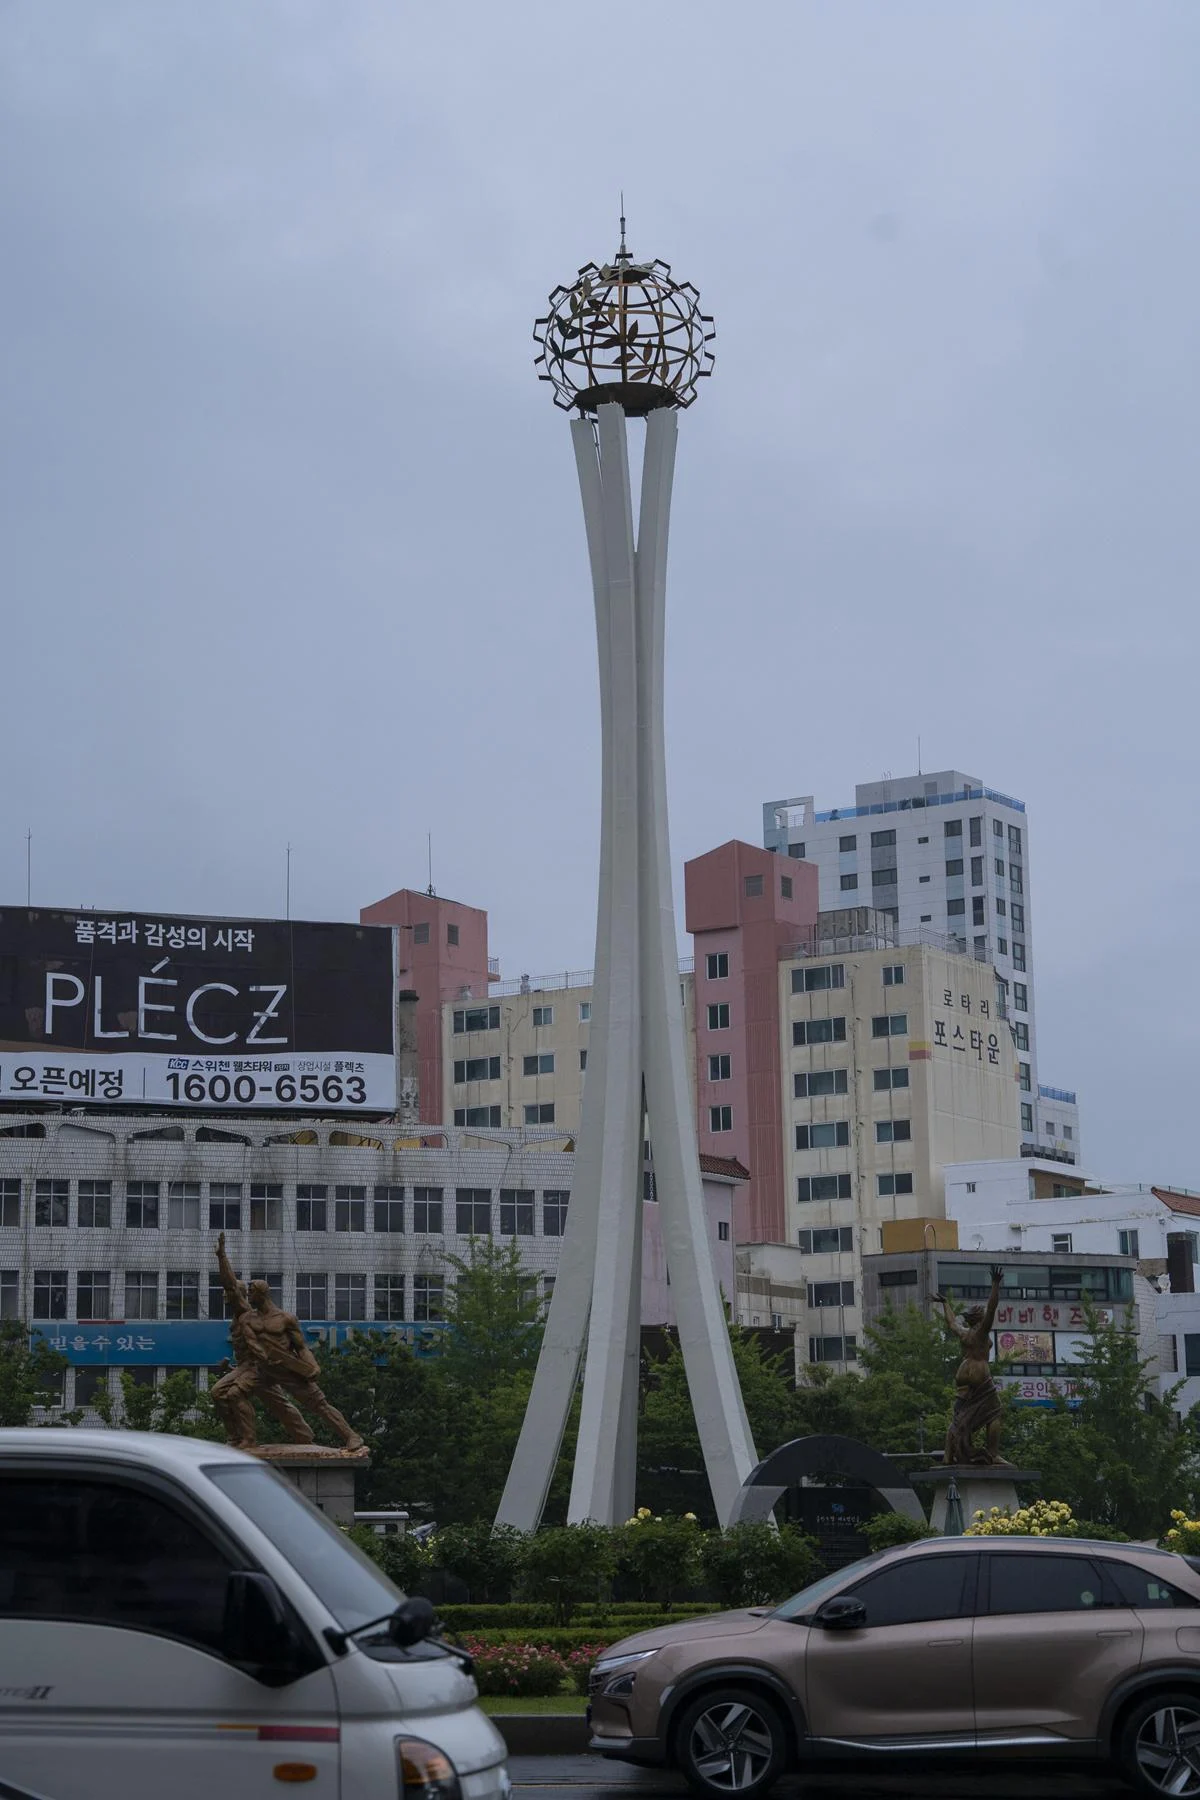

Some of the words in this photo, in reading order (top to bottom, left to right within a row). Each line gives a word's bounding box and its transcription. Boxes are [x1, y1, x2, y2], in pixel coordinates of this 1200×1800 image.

[74, 919, 139, 945] 품격과
[143, 923, 207, 952] 감성의
[212, 928, 255, 953] 시작
[943, 989, 990, 1019] 로타리
[934, 1020, 1000, 1065] 포스타운
[168, 1058, 189, 1070] KCC
[191, 1060, 231, 1073] 스위첸
[233, 1061, 273, 1073] 웰츠타워
[298, 1060, 332, 1072] 상업시설
[334, 1061, 365, 1073] 플렉츠
[10, 1066, 124, 1099] 오픈예정
[166, 1072, 367, 1104] 1600-6563
[50, 1335, 111, 1351] 믿을수
[116, 1335, 156, 1351] 있는
